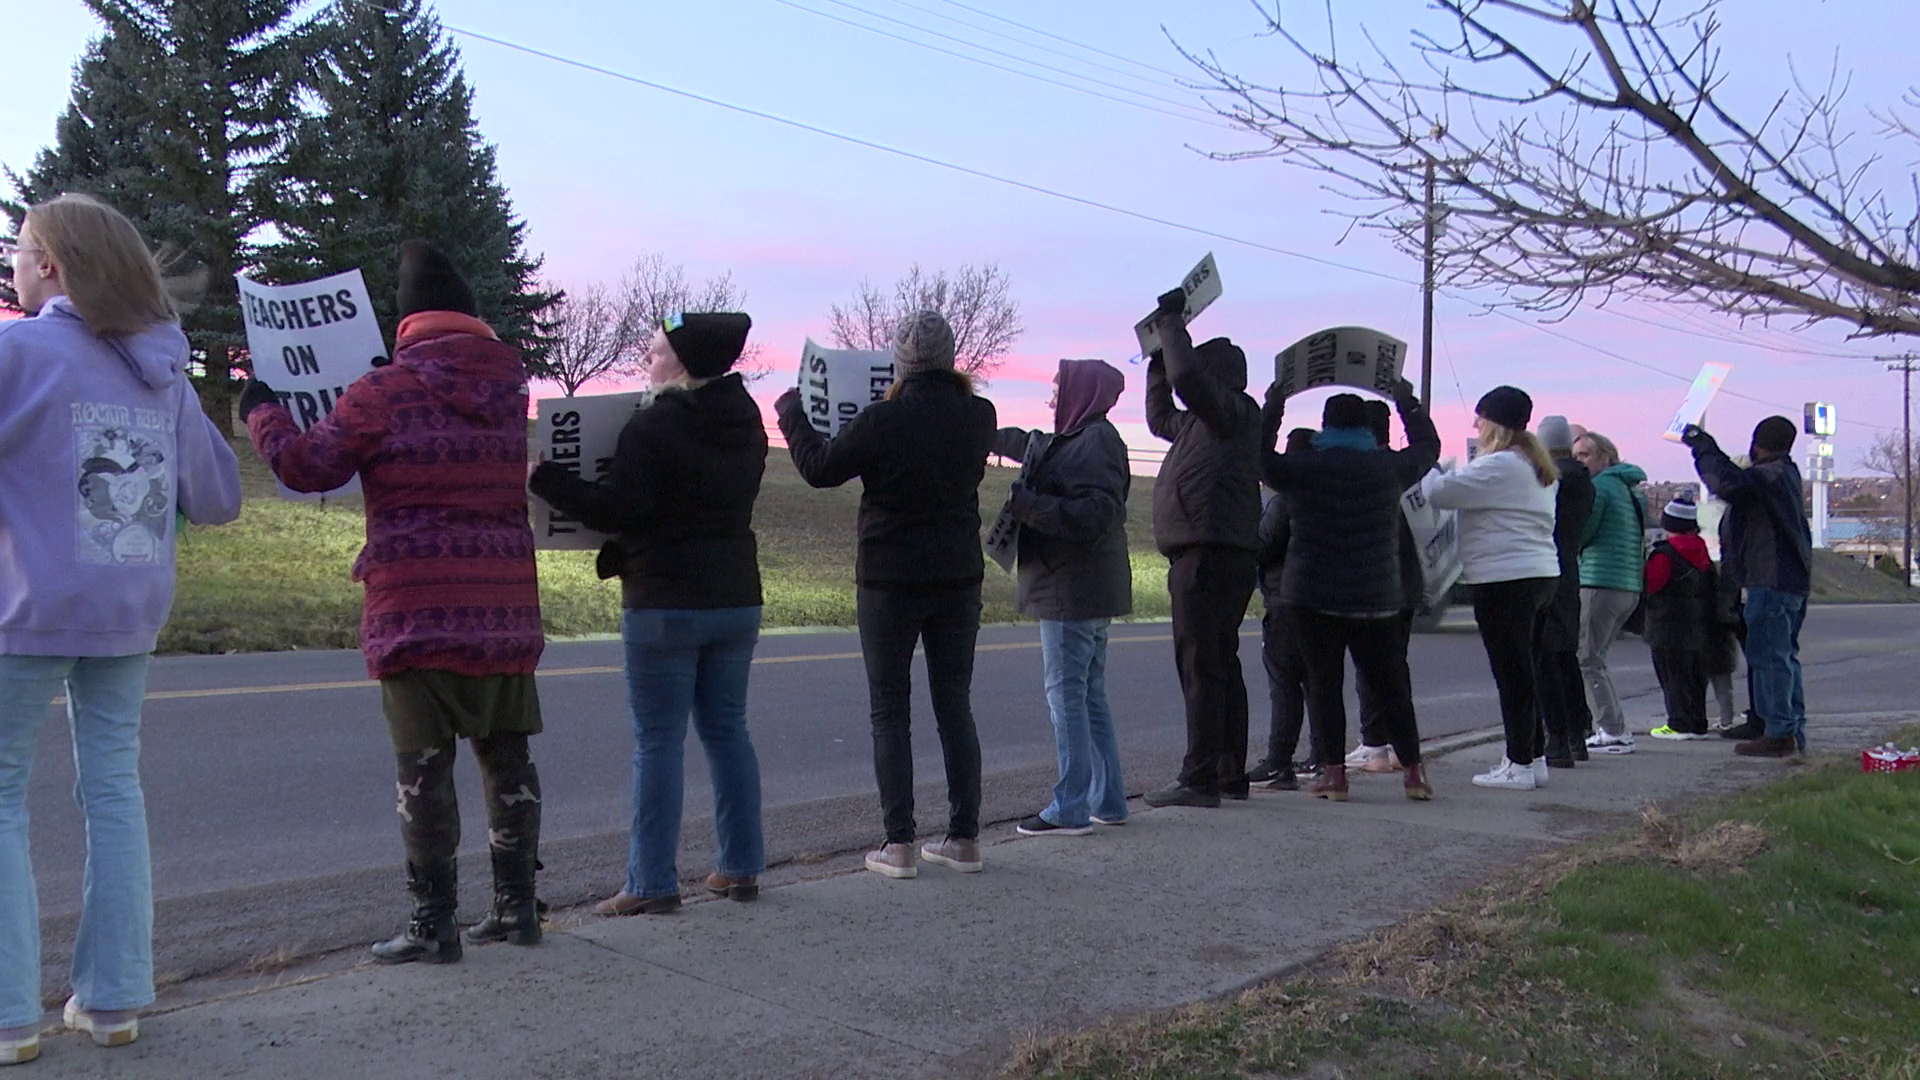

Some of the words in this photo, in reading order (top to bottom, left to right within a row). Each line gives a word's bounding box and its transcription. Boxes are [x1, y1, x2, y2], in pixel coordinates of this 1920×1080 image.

[244, 289, 358, 331] TEACHERS
[282, 345, 321, 377] ON
[274, 386, 344, 430] TRI
[809, 354, 831, 439] STRI
